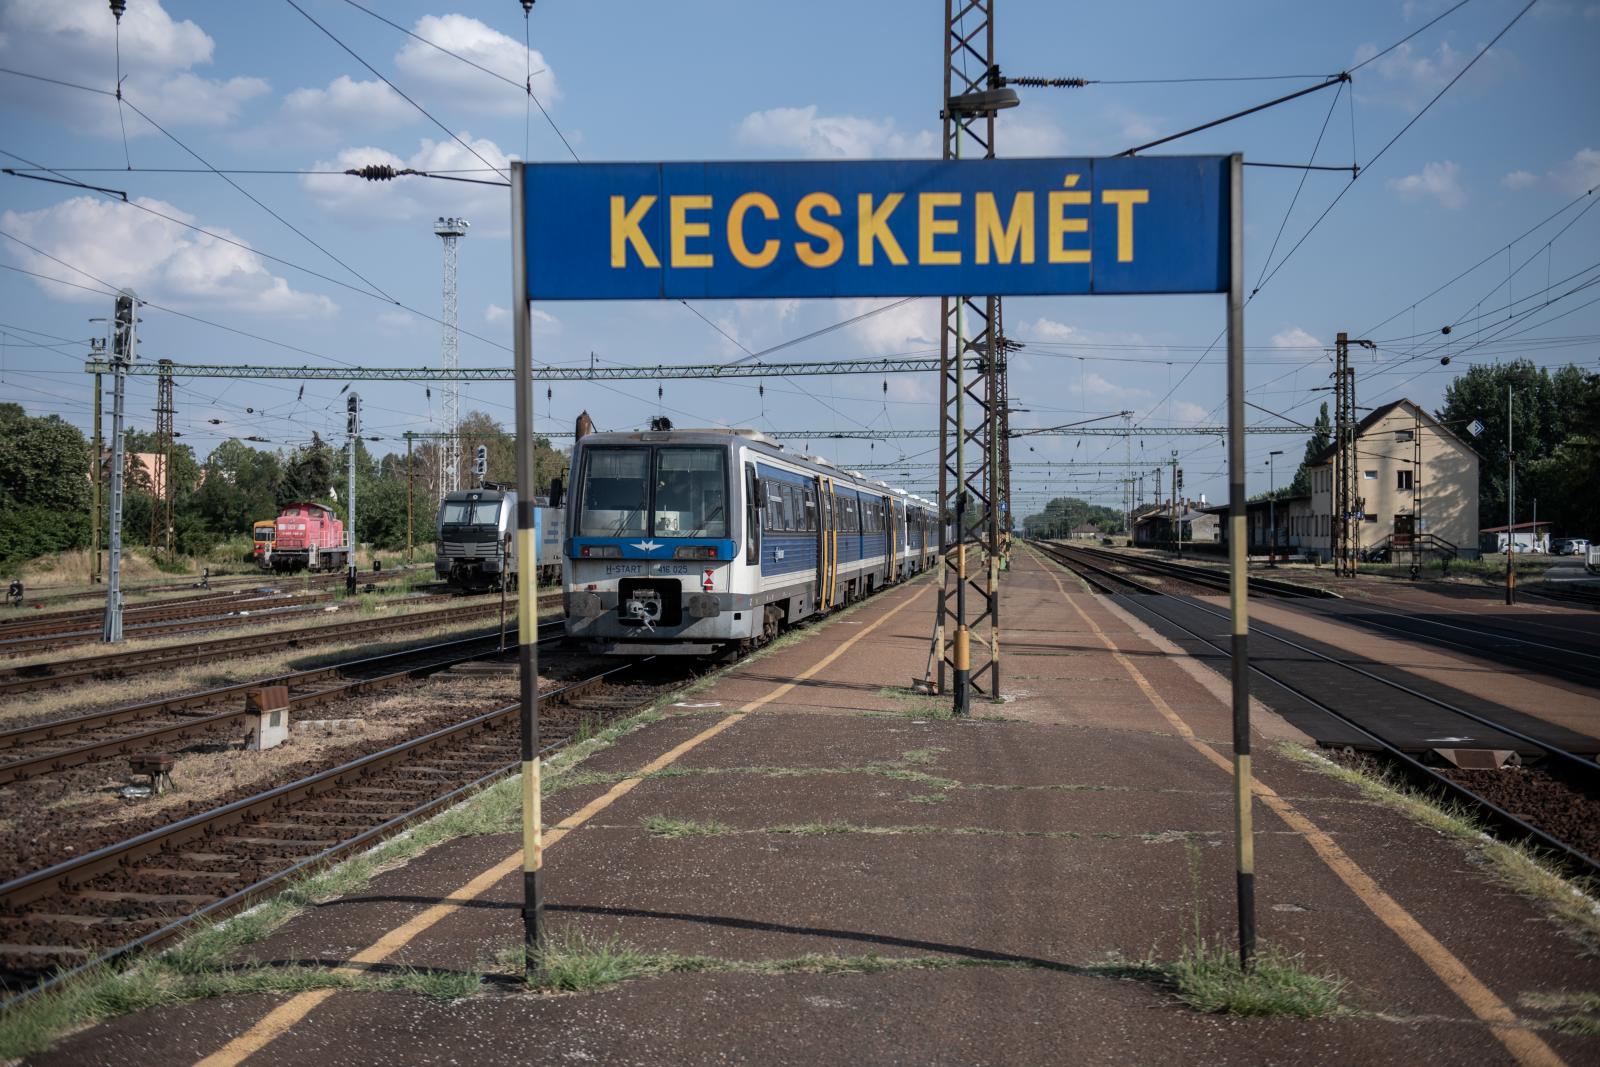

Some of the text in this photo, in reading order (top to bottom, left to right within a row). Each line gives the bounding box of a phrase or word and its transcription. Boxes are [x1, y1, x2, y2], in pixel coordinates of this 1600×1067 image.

[610, 174, 1149, 269] KECSKEMÉT
[606, 565, 642, 574] H-START
[672, 565, 688, 574] 025
